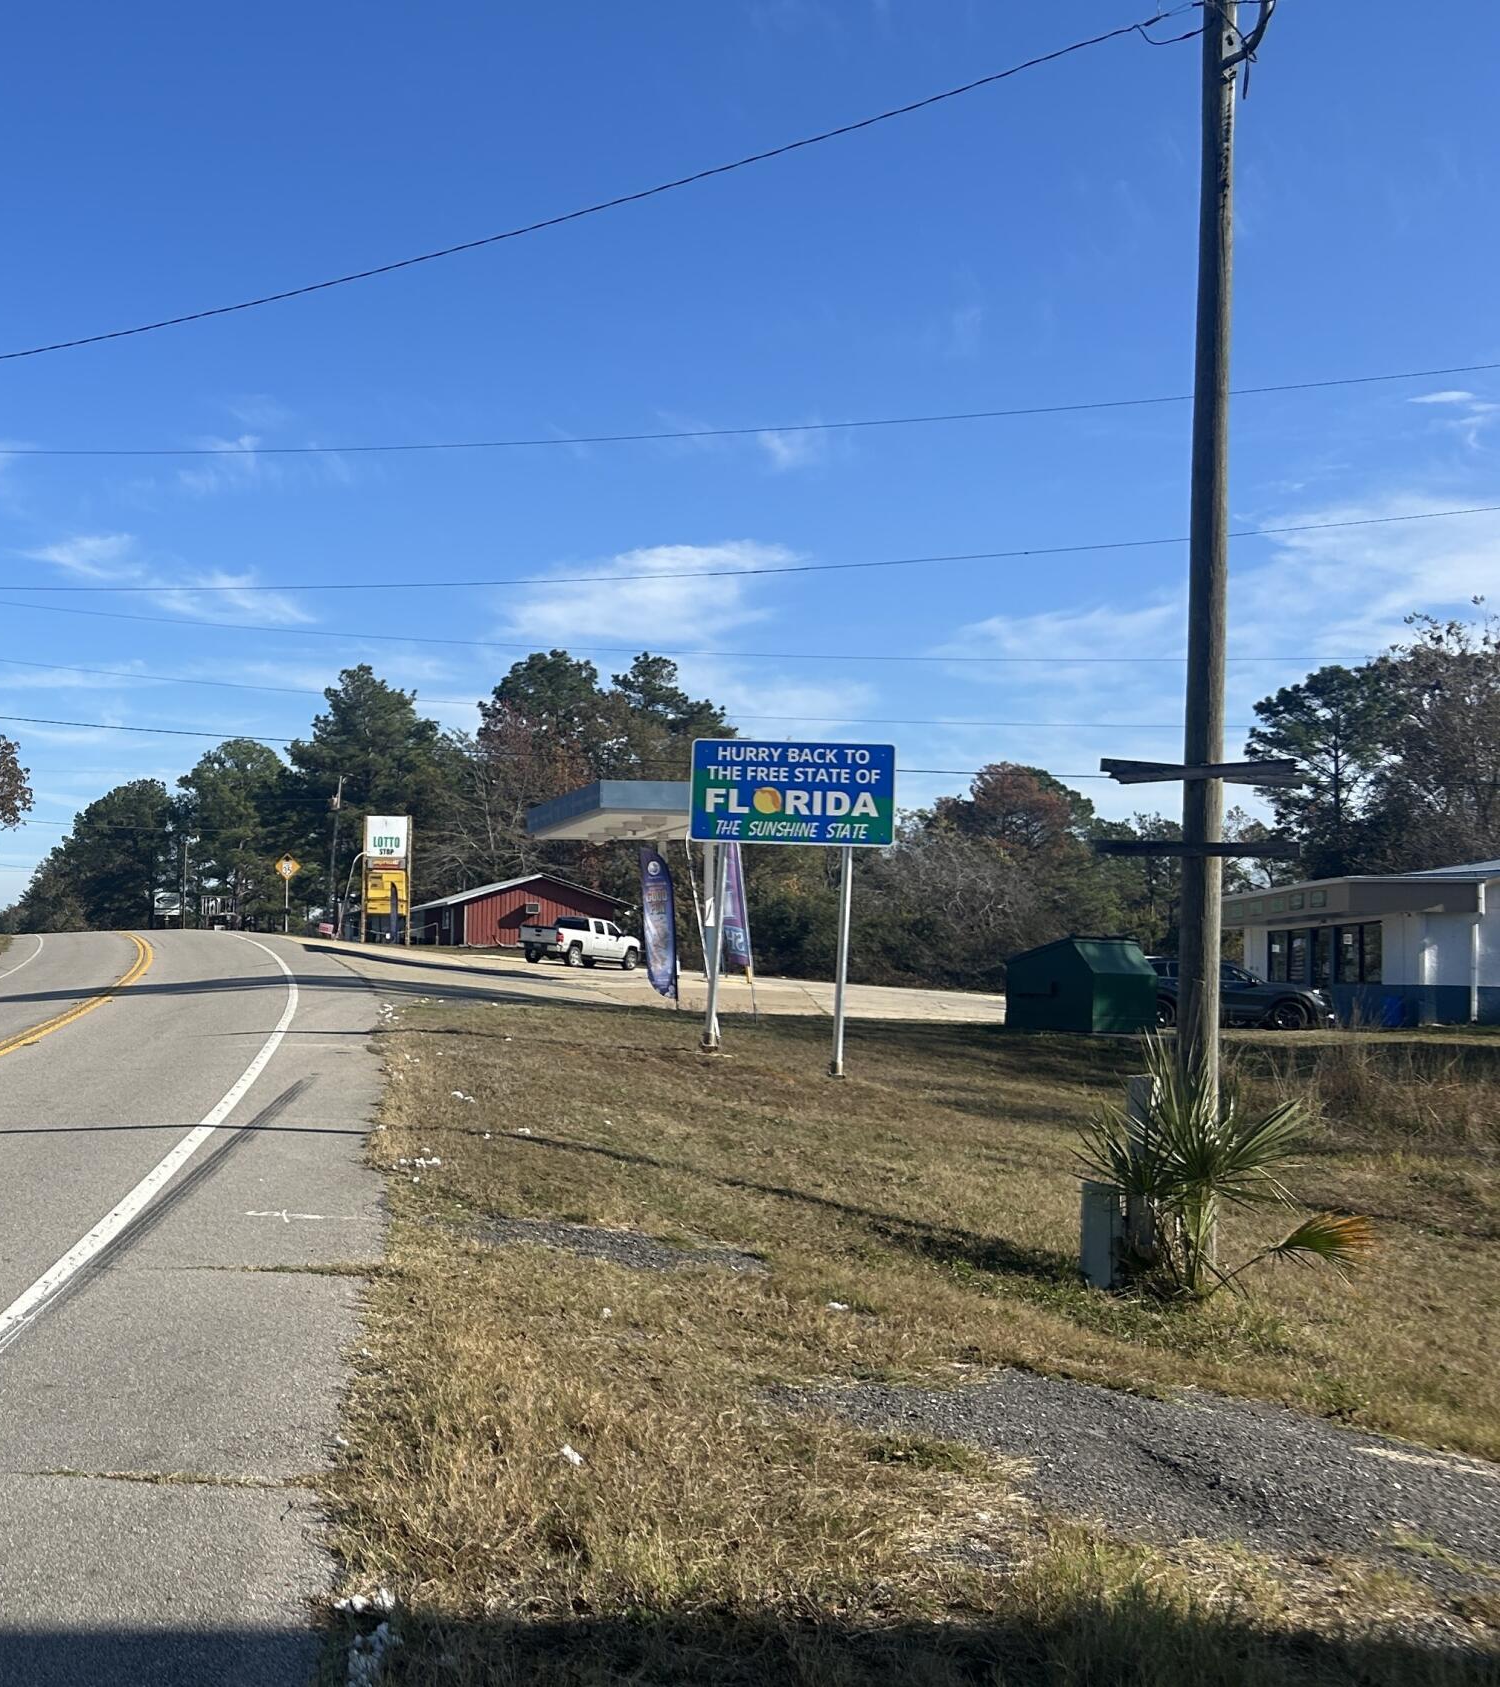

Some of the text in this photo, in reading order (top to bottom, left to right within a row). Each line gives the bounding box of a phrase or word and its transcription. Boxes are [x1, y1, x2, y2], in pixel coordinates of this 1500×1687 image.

[718, 747, 870, 764] HURRY BACK TO
[707, 765, 881, 785] THE FREE STATE OF
[705, 786, 880, 818] FLORIDA
[716, 820, 869, 840] THE SUNSHINE STATE
[373, 836, 400, 848] LOTTO
